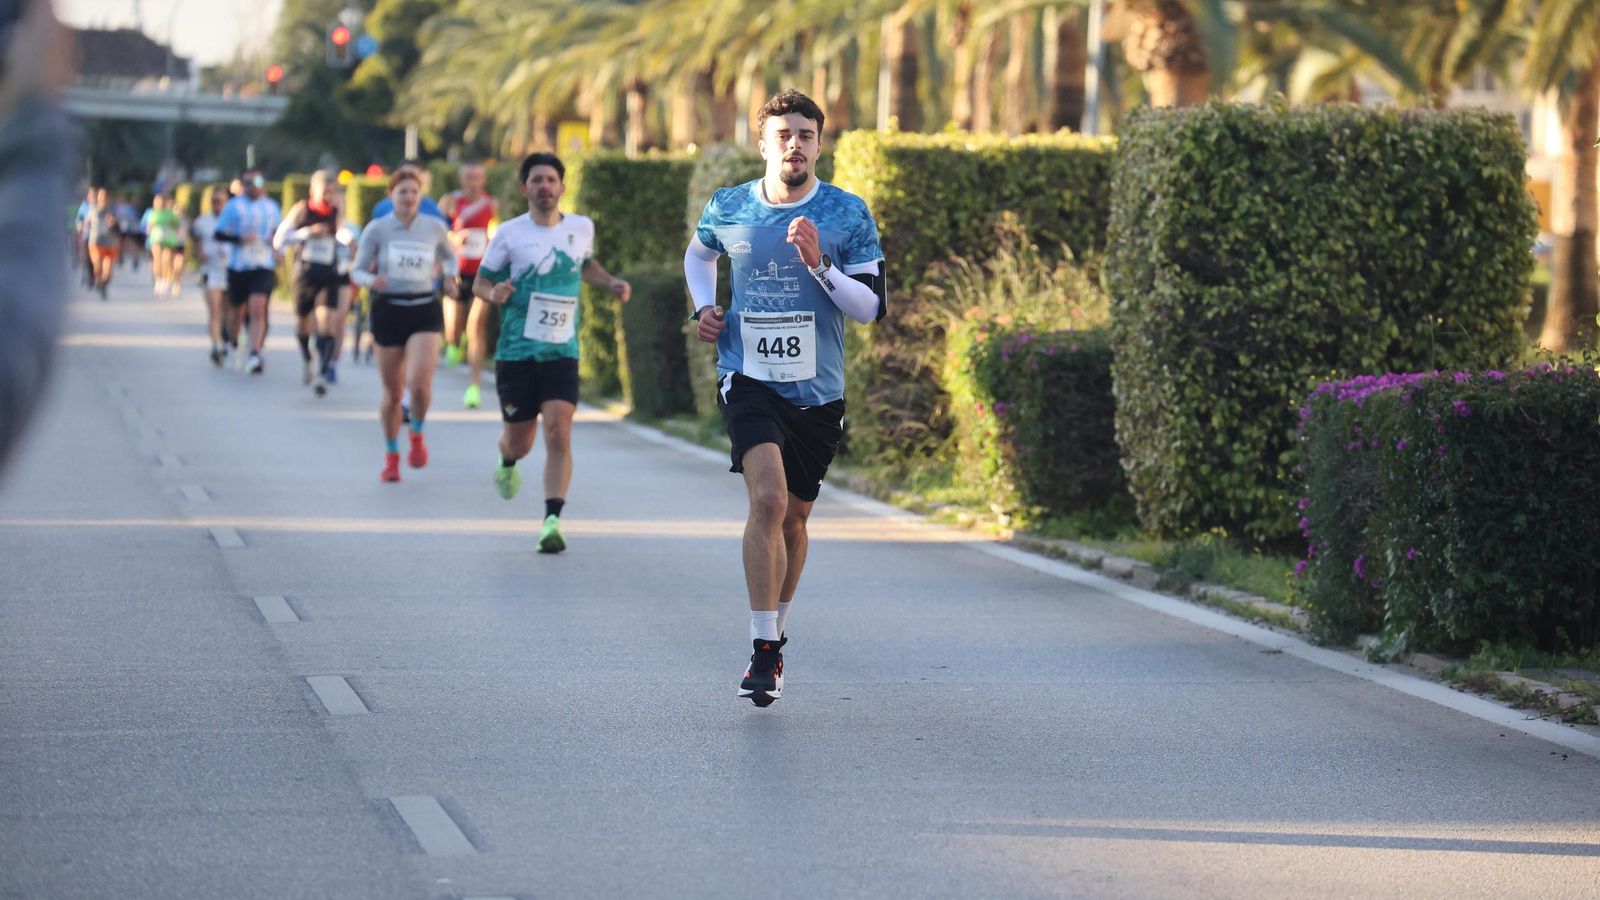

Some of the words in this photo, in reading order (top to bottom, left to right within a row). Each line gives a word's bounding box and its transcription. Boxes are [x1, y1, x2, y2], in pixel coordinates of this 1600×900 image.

[398, 254, 422, 269] 262
[538, 310, 567, 328] 259
[757, 336, 801, 358] 448
